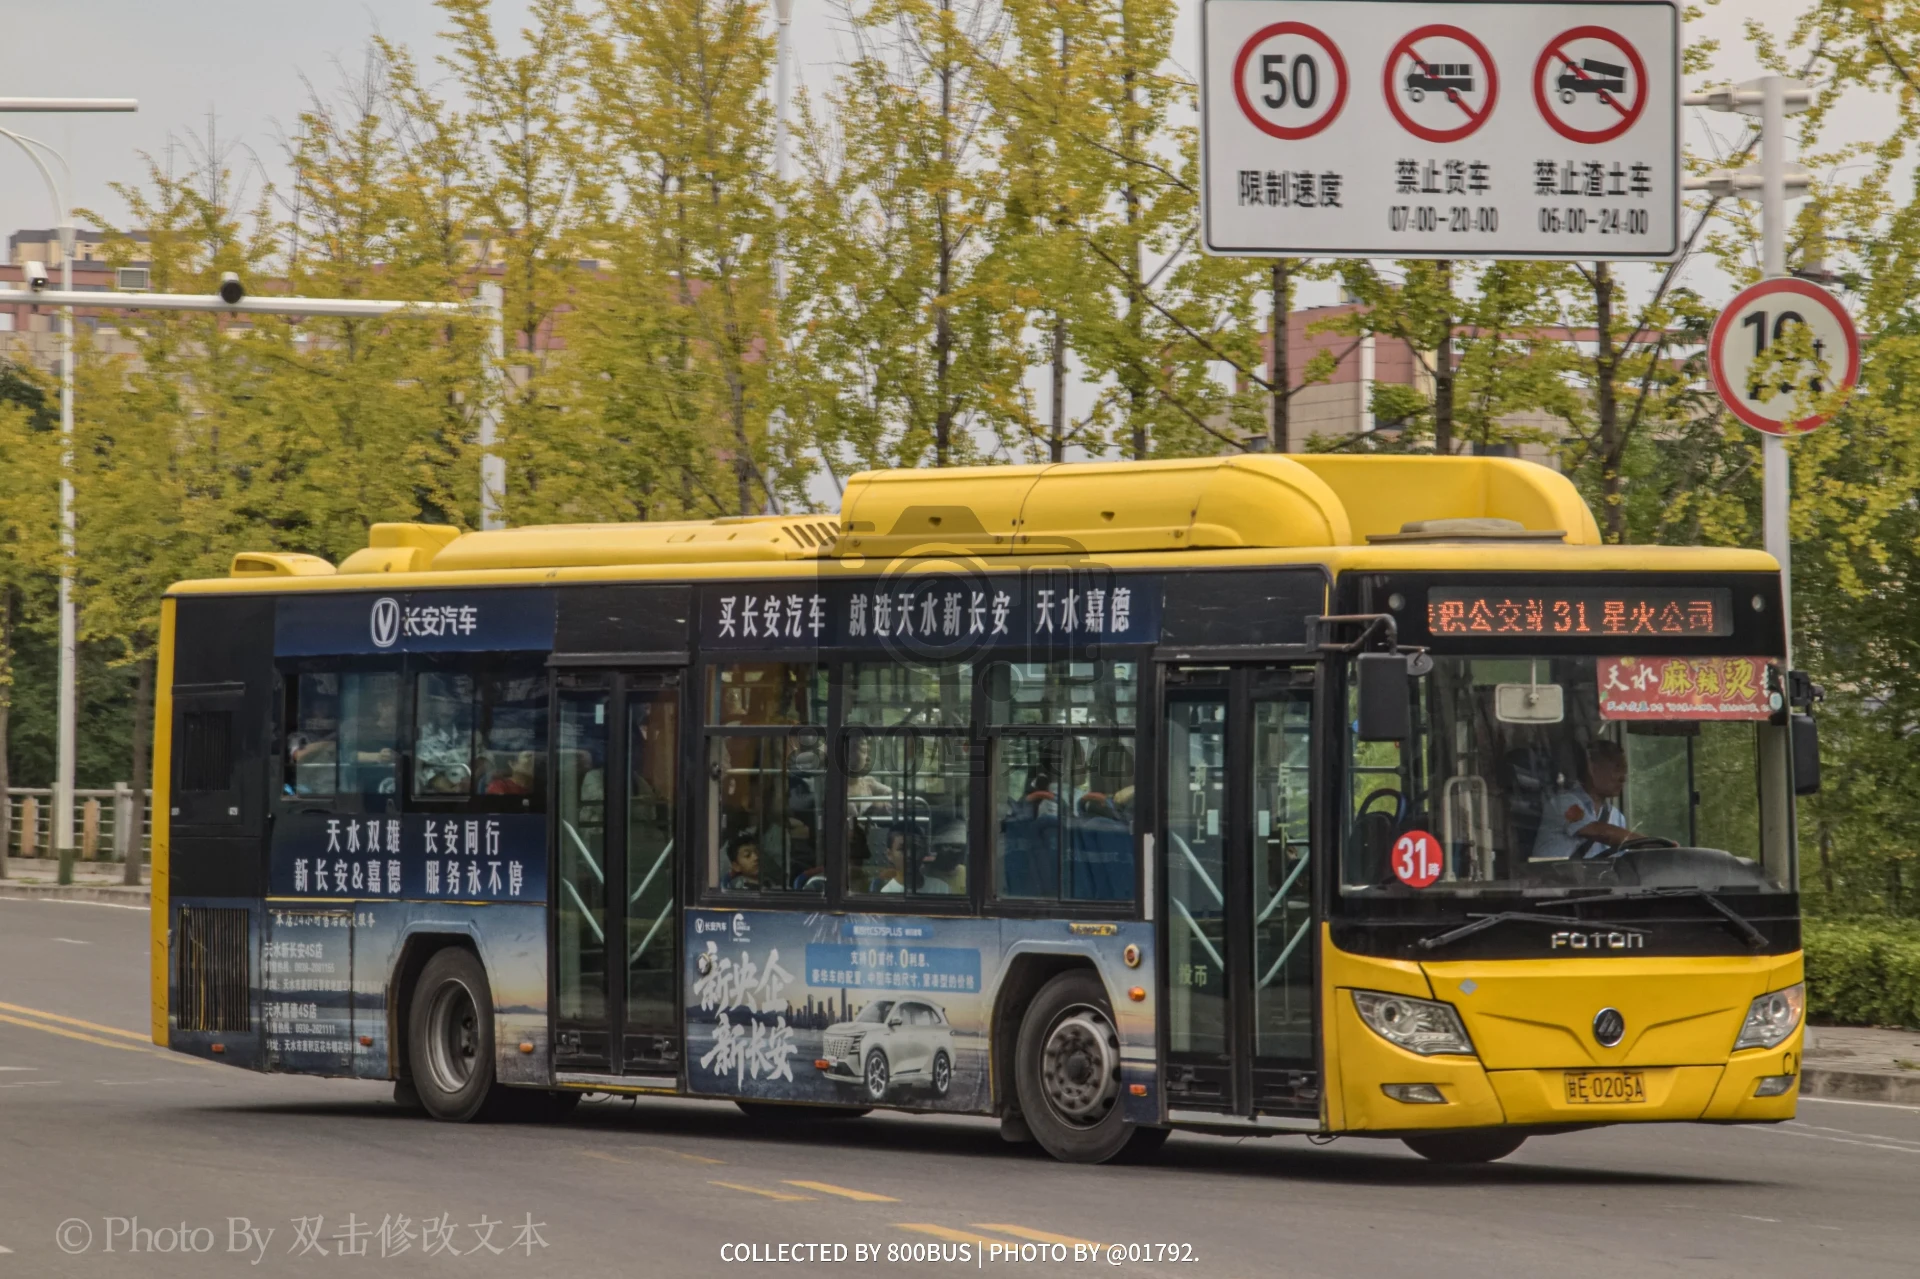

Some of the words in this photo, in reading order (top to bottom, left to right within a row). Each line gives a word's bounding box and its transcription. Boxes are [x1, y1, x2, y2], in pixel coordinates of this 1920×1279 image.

[1261, 54, 1319, 109] 50
[1237, 169, 1344, 209] 限制速度
[1395, 158, 1492, 196] 禁止货车
[1532, 160, 1653, 198] 禁止渣土车
[1388, 205, 1499, 233] 07:00-20:00
[403, 604, 478, 636] 长安汽车
[717, 593, 827, 639] 买长安汽车
[848, 589, 1011, 638] 就选天水新长安
[1035, 586, 1132, 635] 天水嘉德
[1552, 600, 1592, 632] 31
[1602, 600, 1714, 634] 星火公司
[326, 819, 401, 853] 天水双雄
[423, 820, 501, 856] 长安同行
[294, 858, 401, 894] 新长安&嘉德
[425, 860, 525, 896] 服务永不停
[1551, 931, 1644, 949] FOTON
[700, 1012, 798, 1092] 新长安
